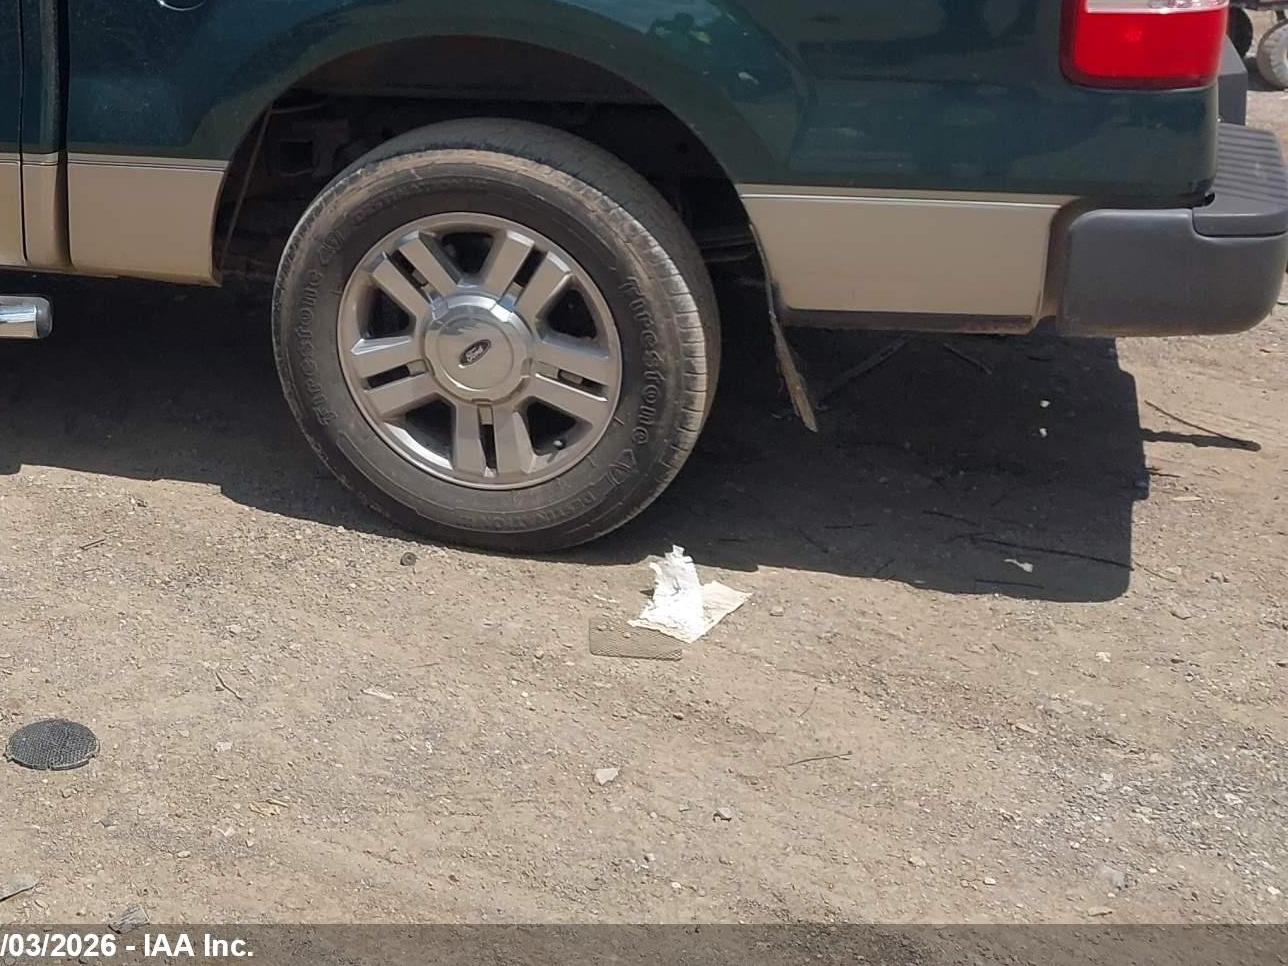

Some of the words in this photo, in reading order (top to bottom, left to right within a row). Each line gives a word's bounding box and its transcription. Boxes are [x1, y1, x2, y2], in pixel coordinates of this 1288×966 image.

[295, 268, 338, 425] Firestone
[465, 341, 484, 358] Ford
[617, 276, 665, 445] Firestone
